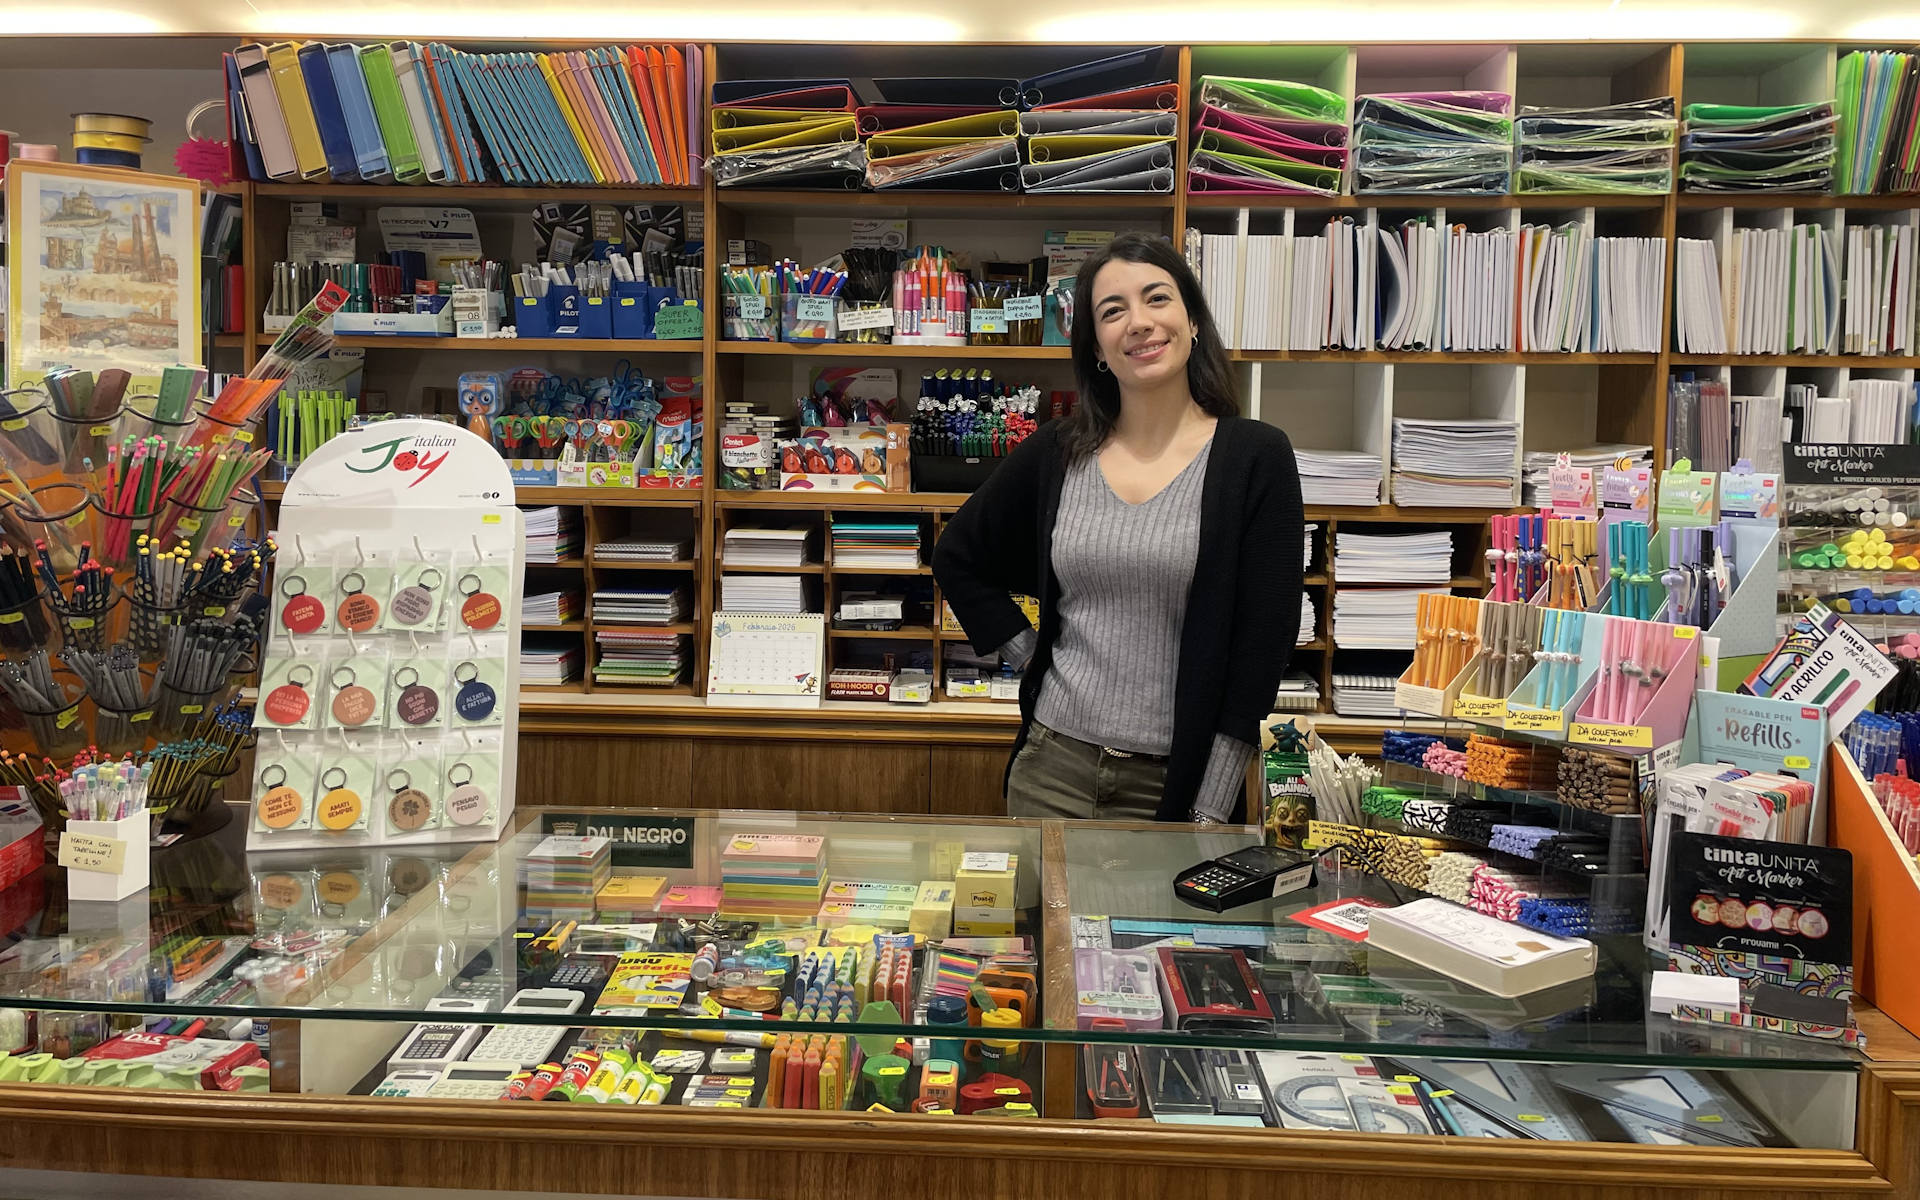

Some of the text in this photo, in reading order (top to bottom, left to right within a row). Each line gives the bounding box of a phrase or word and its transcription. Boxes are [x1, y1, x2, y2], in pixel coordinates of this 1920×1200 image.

[428, 220, 449, 229] V7
[662, 309, 689, 318] SUPER
[661, 413, 687, 423] Maped
[414, 434, 457, 447] italian
[723, 438, 744, 447] Pentel
[1793, 445, 1886, 459] tintaUNITA
[1807, 459, 1874, 475] Art Marker
[1551, 471, 1575, 484] Lovely
[1865, 476, 1892, 484] ACRILICO
[404, 590, 416, 599] NON
[347, 604, 370, 615] STANCO
[349, 599, 367, 608] SONO
[352, 609, 375, 619] ESSERE
[463, 609, 475, 618] NEL
[742, 622, 777, 631] Febbraio
[1838, 629, 1889, 675] tintaUNITA
[1791, 649, 1835, 696] ACRILICO
[274, 697, 304, 709] PERSONA
[465, 691, 486, 703] ALZATI
[467, 695, 492, 710] FATTURA
[269, 702, 303, 716] PREFERITA
[412, 704, 426, 713] CHE
[1454, 700, 1467, 709] DA
[407, 706, 436, 722] CASSETTI
[1507, 710, 1518, 719] DA
[1725, 706, 1793, 723] ERASABLE PEN
[1577, 725, 1589, 736] DA
[1724, 717, 1794, 750] Refills
[264, 792, 294, 807] COME TE
[451, 794, 480, 808] PENSAVO
[267, 803, 283, 813] NON
[327, 806, 354, 818] SEMPRE
[329, 800, 351, 812] AMATI
[455, 802, 478, 814] PEGGIO
[1686, 806, 1699, 814] pen
[266, 805, 297, 820] NESSUNO
[1714, 801, 1757, 825] Erasable pen
[586, 825, 687, 845] DAL NEGRO
[73, 856, 81, 864] €
[1703, 846, 1820, 874] tintaUNITA
[1718, 866, 1804, 889] Art Marker
[973, 895, 995, 904] Post-it
[1740, 937, 1780, 950] provami!
[620, 957, 662, 965] UHU
[615, 964, 691, 973] patafix
[419, 1023, 473, 1031] PORTABLE
[123, 1033, 164, 1046] DAS
[218, 1065, 231, 1078] DAS
